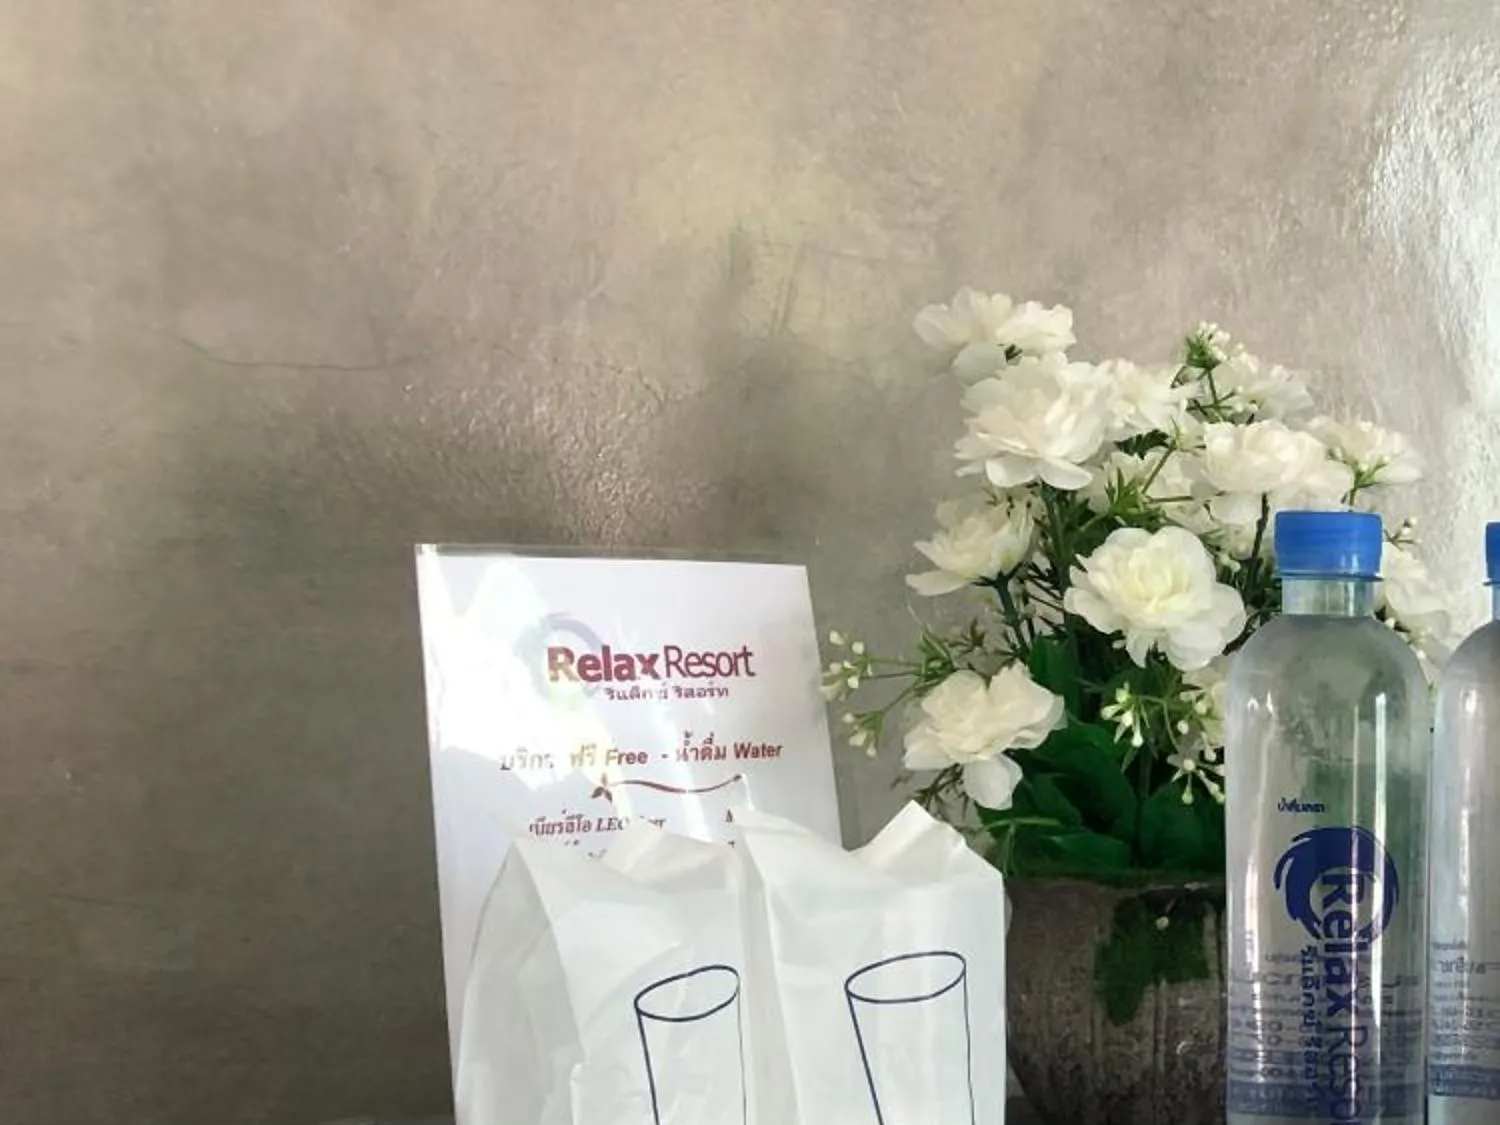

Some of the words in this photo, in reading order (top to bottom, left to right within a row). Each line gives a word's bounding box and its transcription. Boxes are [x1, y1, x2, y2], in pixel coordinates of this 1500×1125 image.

[547, 644, 661, 682] Relax
[663, 645, 757, 678] Resort
[604, 749, 648, 765] Free
[733, 742, 784, 760] Water
[1321, 873, 1370, 1017] Relax
